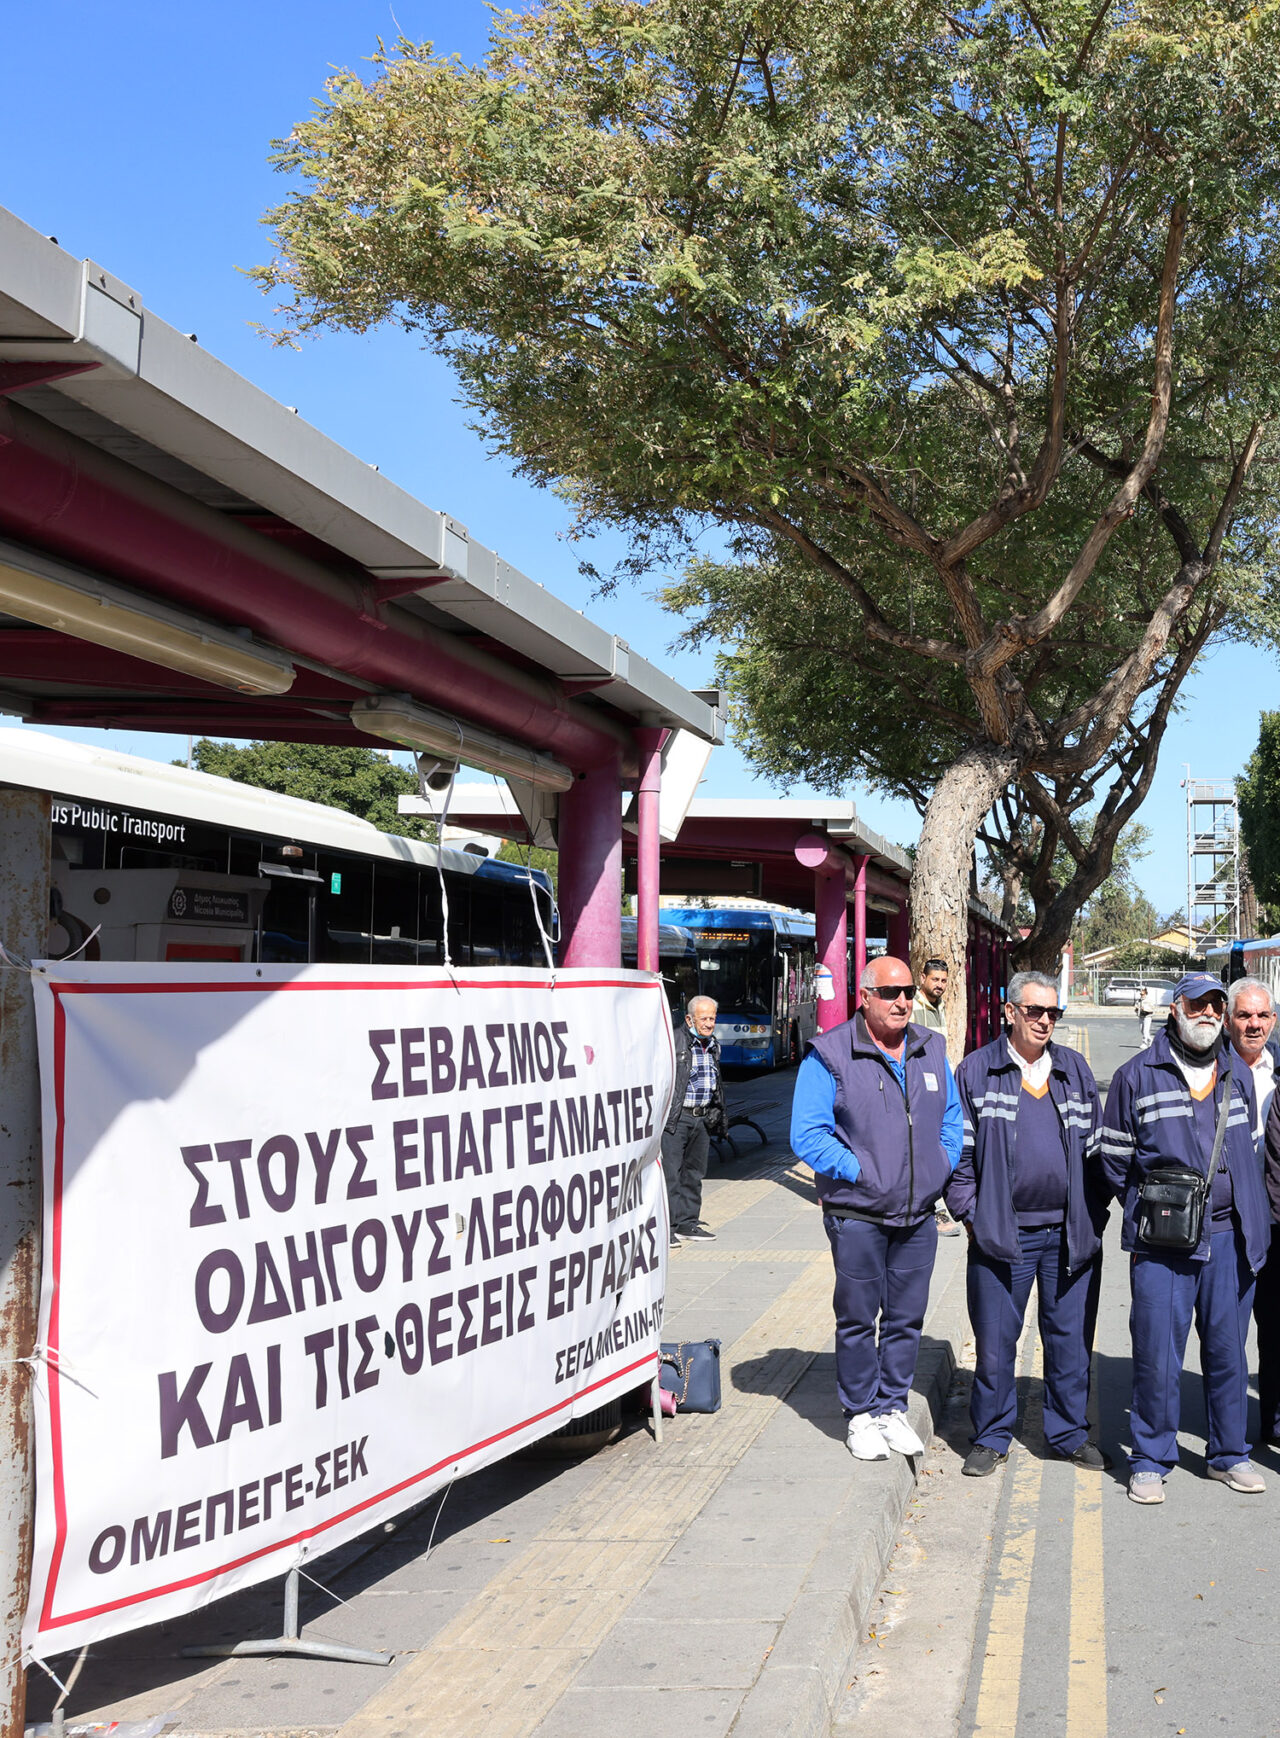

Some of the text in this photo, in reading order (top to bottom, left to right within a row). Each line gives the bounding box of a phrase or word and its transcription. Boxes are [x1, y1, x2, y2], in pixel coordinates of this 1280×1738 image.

[71, 804, 118, 832] Public
[121, 812, 186, 844] Transport
[368, 1021, 577, 1101] ΣΕΒΑΣΜΟΣ
[180, 1085, 655, 1228] ΣΤΟΥΣ ΕΠΑΓΓΕΛΜΑΤΙΕΣ
[195, 1155, 648, 1334] ΟΔΗΓΟΥΣ ΛΕΩΦΟΡΕΙΩΝ
[157, 1216, 660, 1460] ΚΑΙ ΤΙΣ ΘΕΣΕΙΣ ΕΡΓΑΣΙΑΣ
[554, 1295, 664, 1386] ΣΕΓΔΑΜΕΛΙΝ-ΠΕ
[88, 1434, 370, 1575] ΟΜΕΠΕΓΕ-ΣΕΚ
